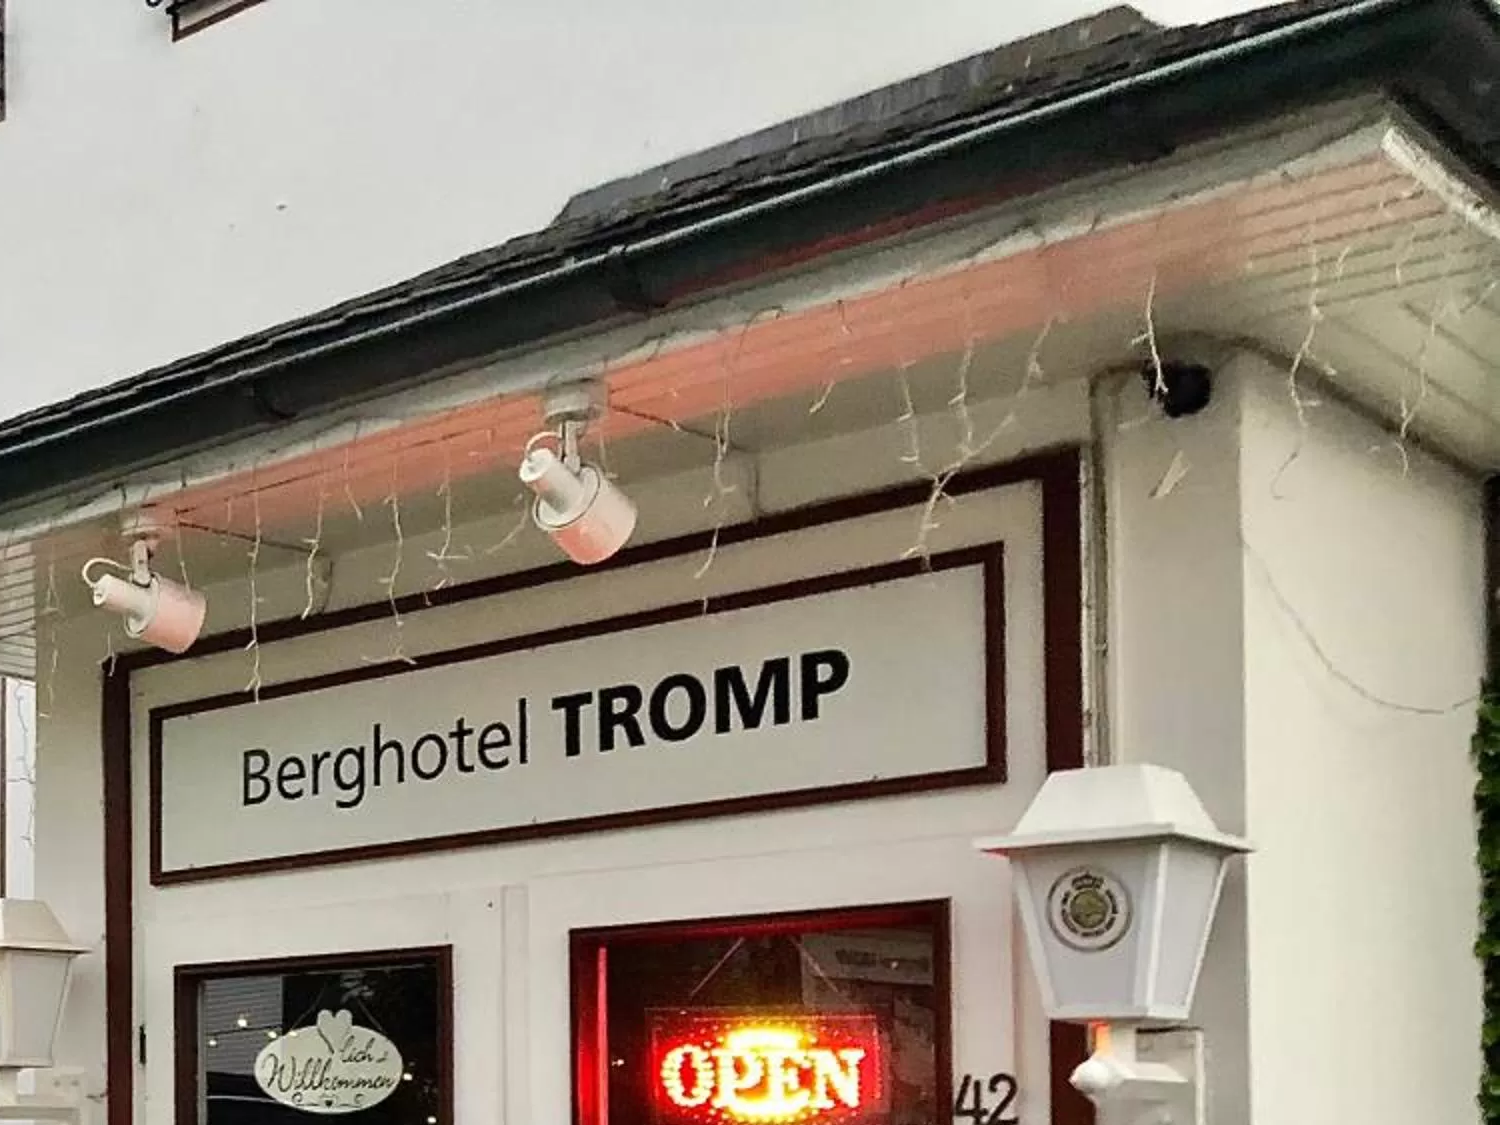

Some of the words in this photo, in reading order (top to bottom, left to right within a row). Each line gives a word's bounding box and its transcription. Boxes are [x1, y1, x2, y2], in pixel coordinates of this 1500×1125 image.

[242, 697, 530, 809] Berghotel
[552, 648, 850, 757] TROMP
[262, 1053, 394, 1092] Willkommen
[661, 1044, 866, 1110] OPEN
